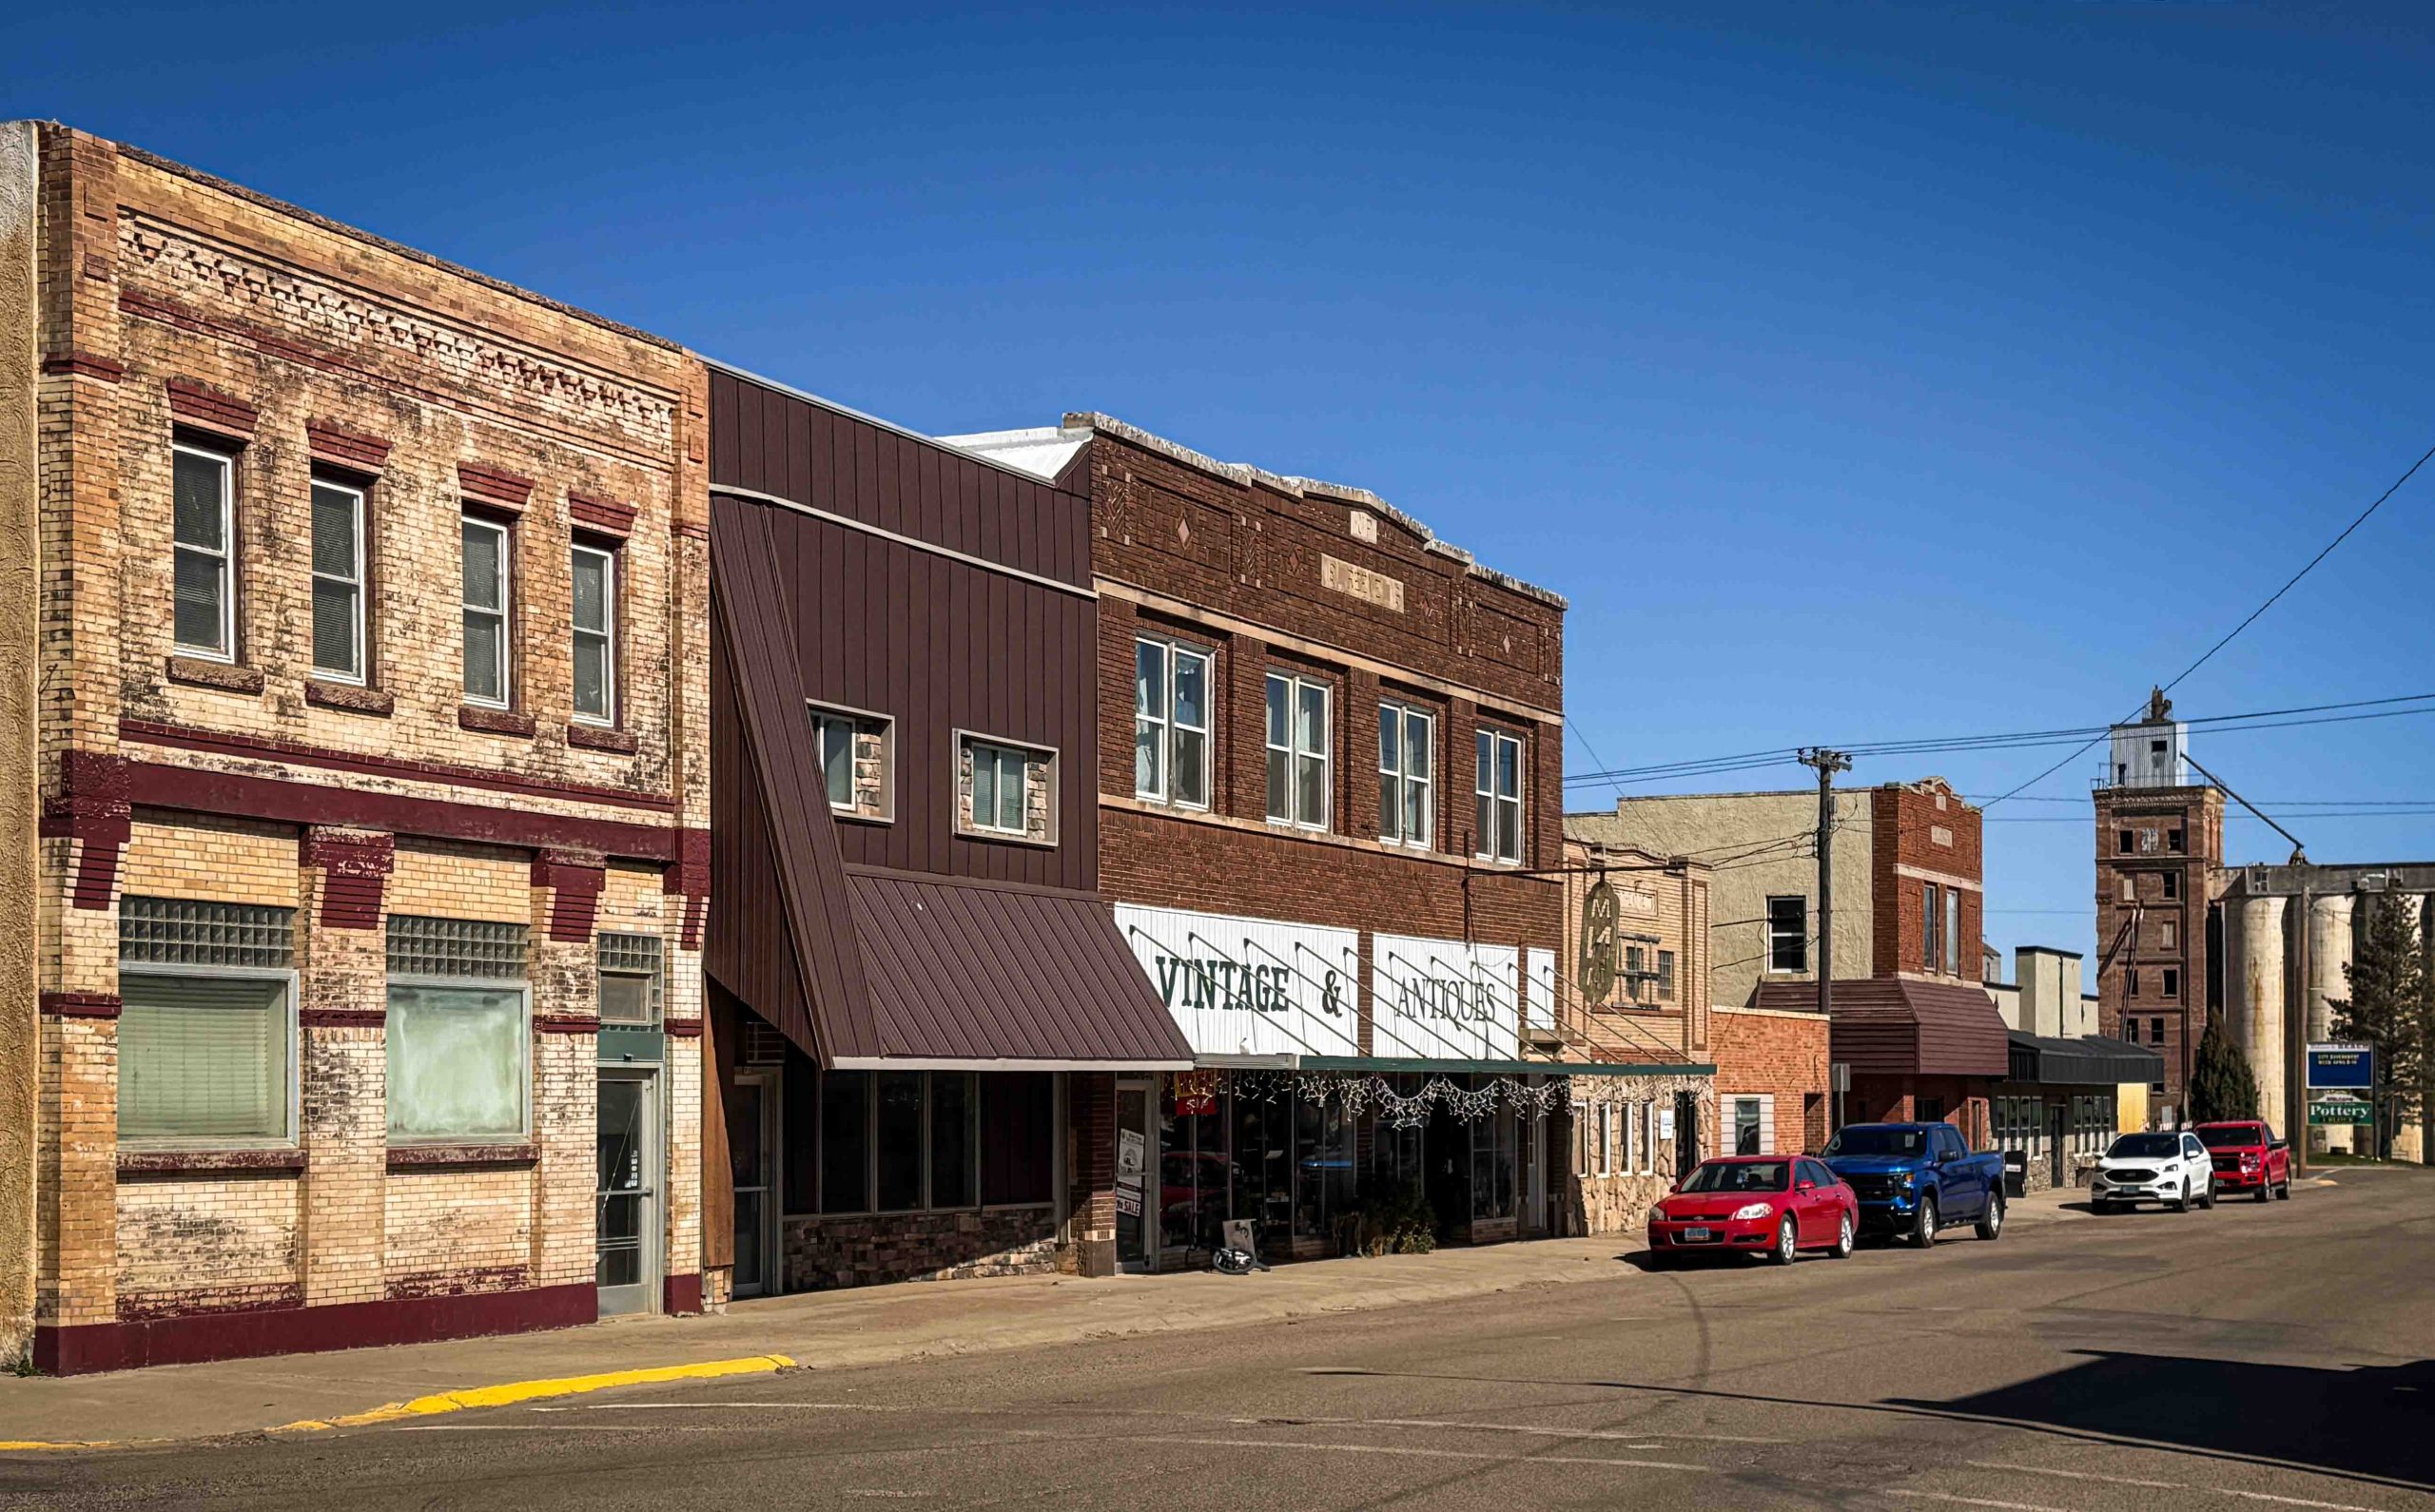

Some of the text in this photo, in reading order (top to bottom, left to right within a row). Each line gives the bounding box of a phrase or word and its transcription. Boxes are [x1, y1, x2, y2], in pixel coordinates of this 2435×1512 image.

[1156, 956, 1343, 1018] VINTAGE &
[1395, 977, 1496, 1031] ANTIQUES
[2310, 1104, 2369, 1118] Pottery
[1124, 1200, 1140, 1215] SALE
